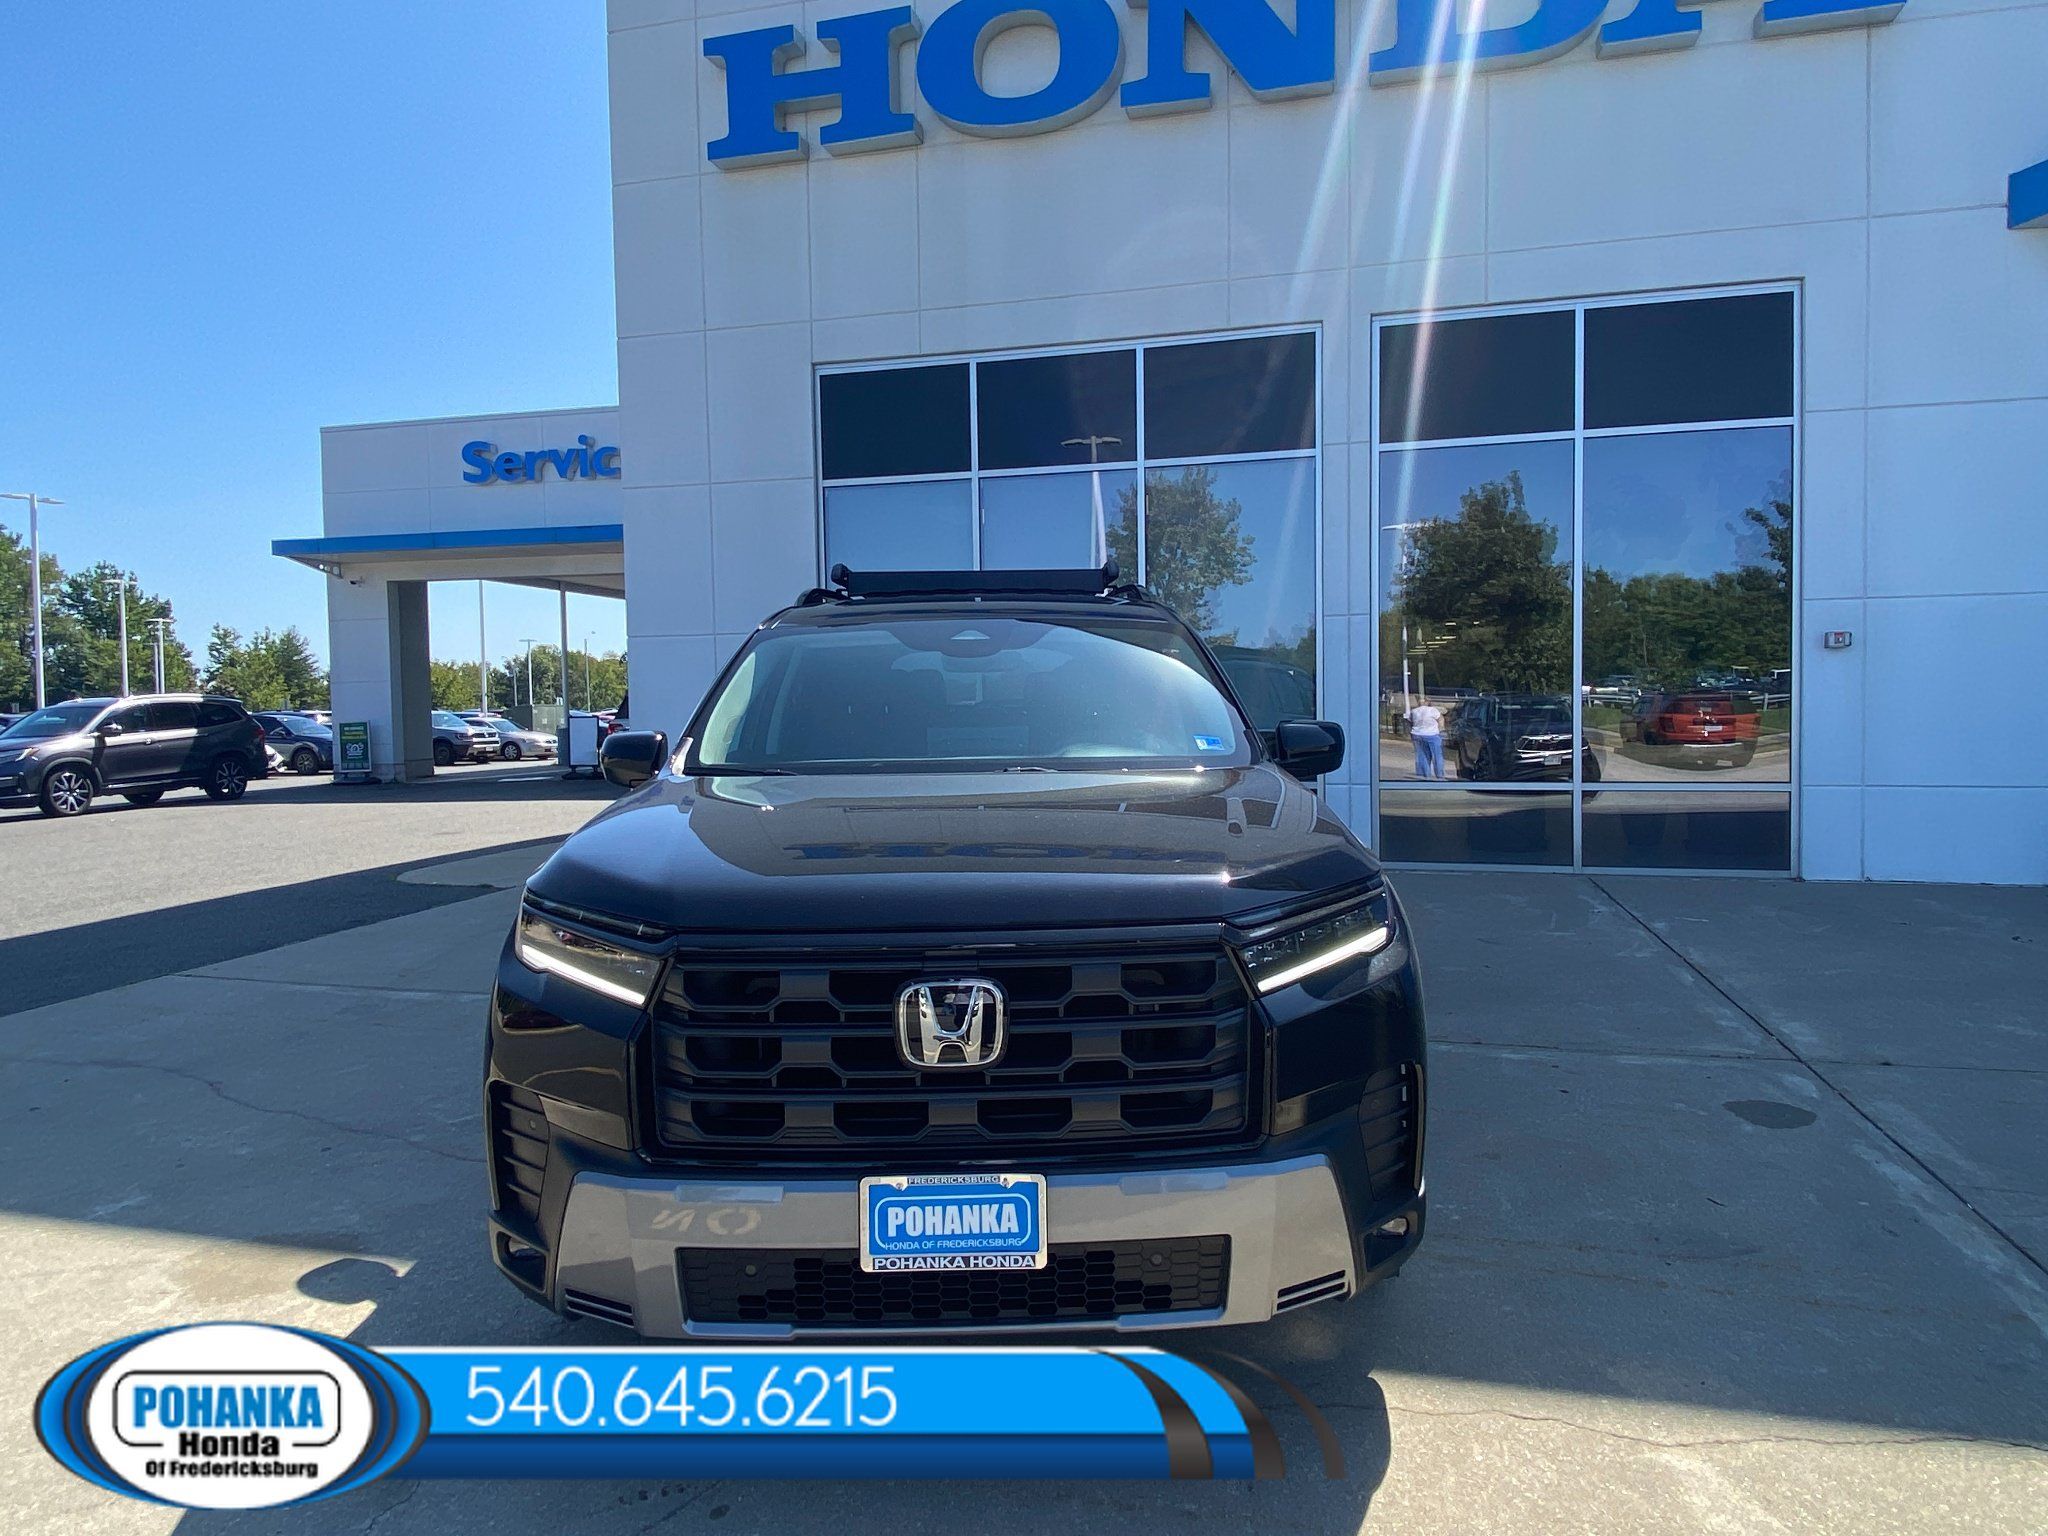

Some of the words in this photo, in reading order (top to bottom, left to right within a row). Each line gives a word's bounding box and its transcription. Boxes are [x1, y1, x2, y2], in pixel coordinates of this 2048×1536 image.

[703, 0, 1908, 166] HOND
[907, 1175, 1000, 1185] FREDERICKSBURG
[887, 1203, 1020, 1238] POHANKA
[885, 1241, 920, 1251] HONDA
[922, 1240, 936, 1249] OF
[937, 1237, 1022, 1249] FREDERICKSBURG
[874, 1256, 966, 1270] POHANKA
[970, 1255, 1036, 1268] HONDA
